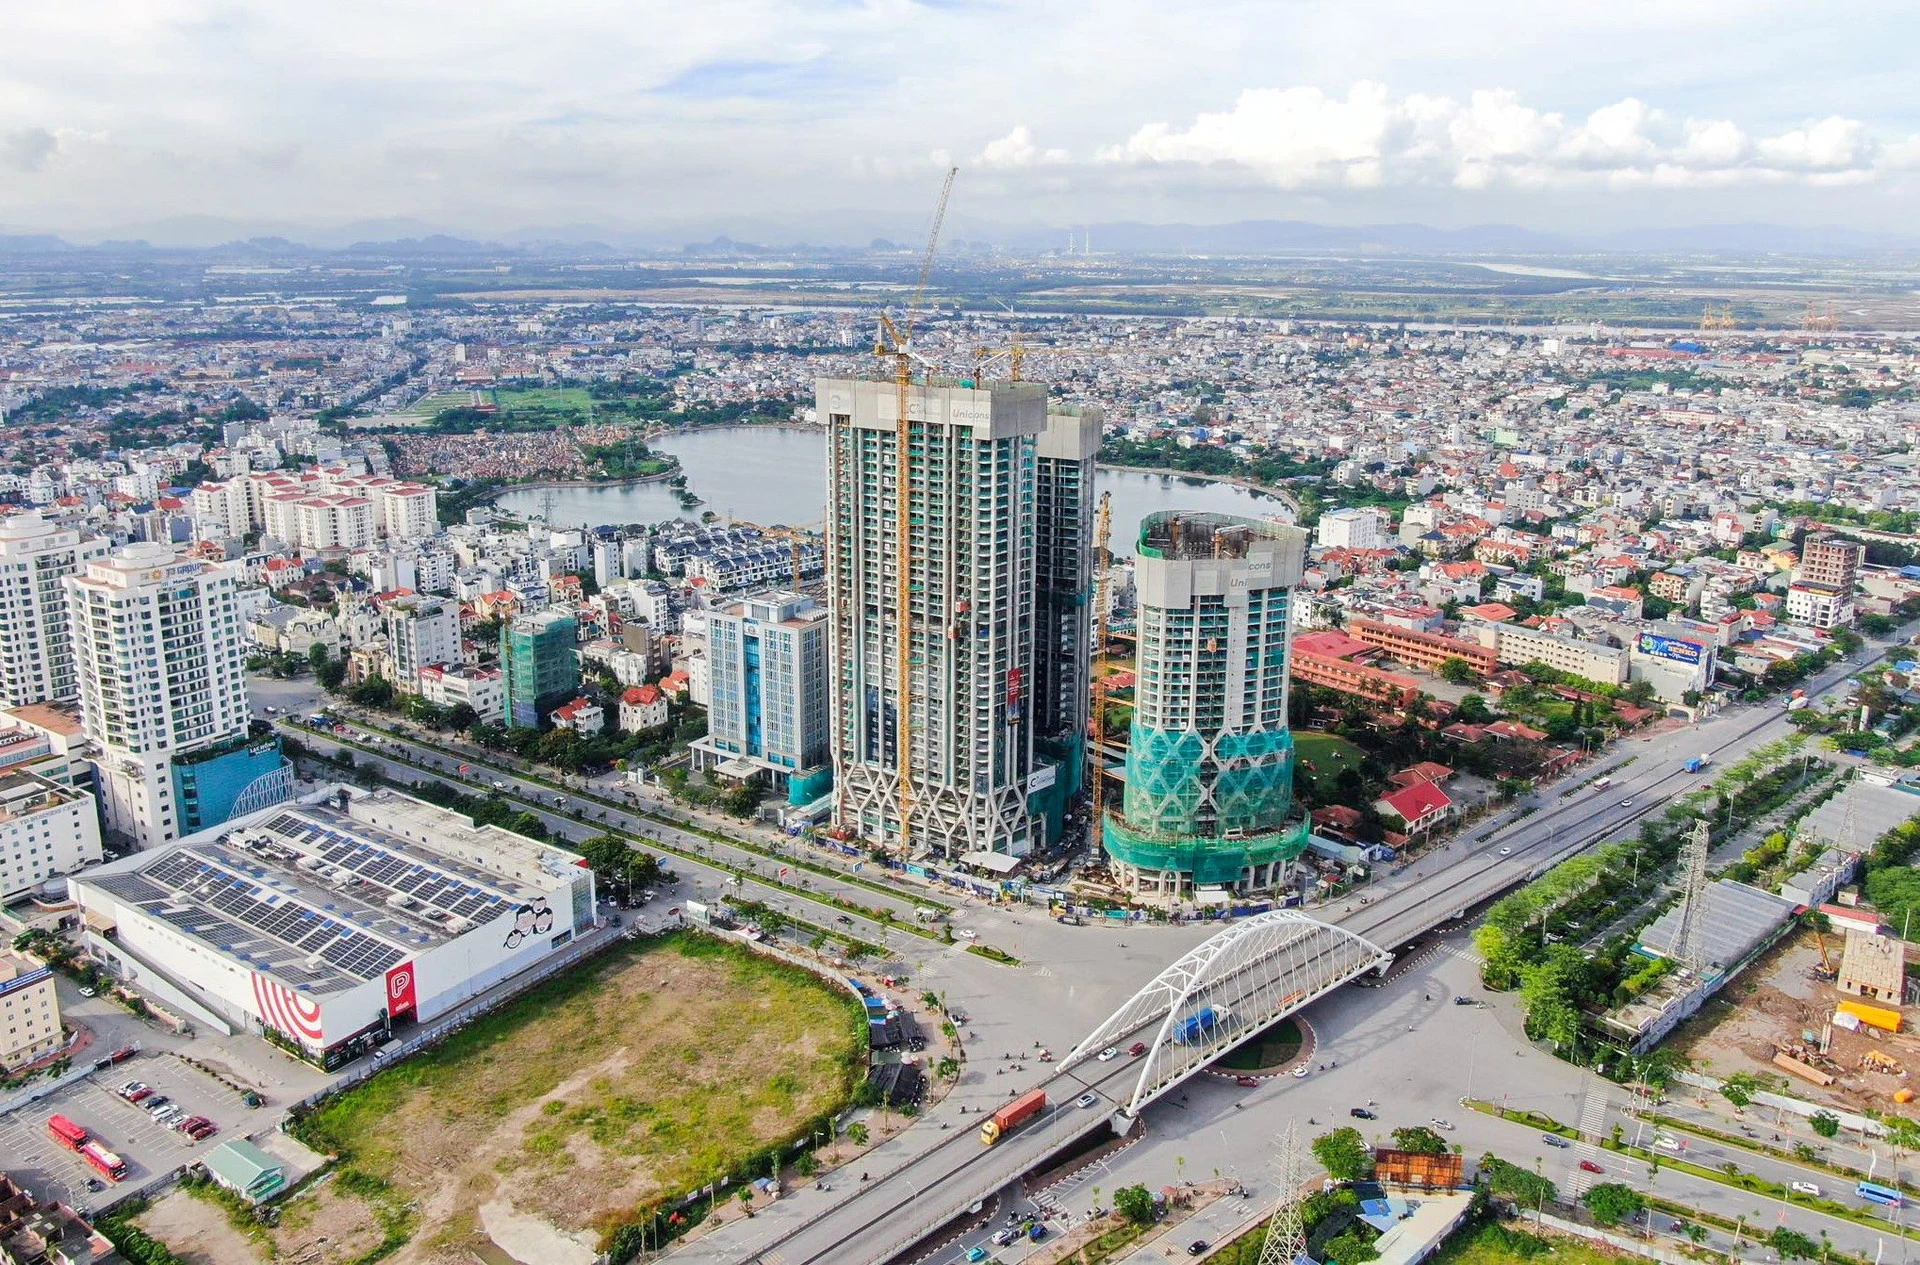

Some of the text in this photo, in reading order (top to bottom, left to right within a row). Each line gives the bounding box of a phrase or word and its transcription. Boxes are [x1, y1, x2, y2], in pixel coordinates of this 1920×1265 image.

[952, 408, 990, 420] Unicons
[177, 562, 202, 575] GROUP
[391, 971, 410, 999] P
